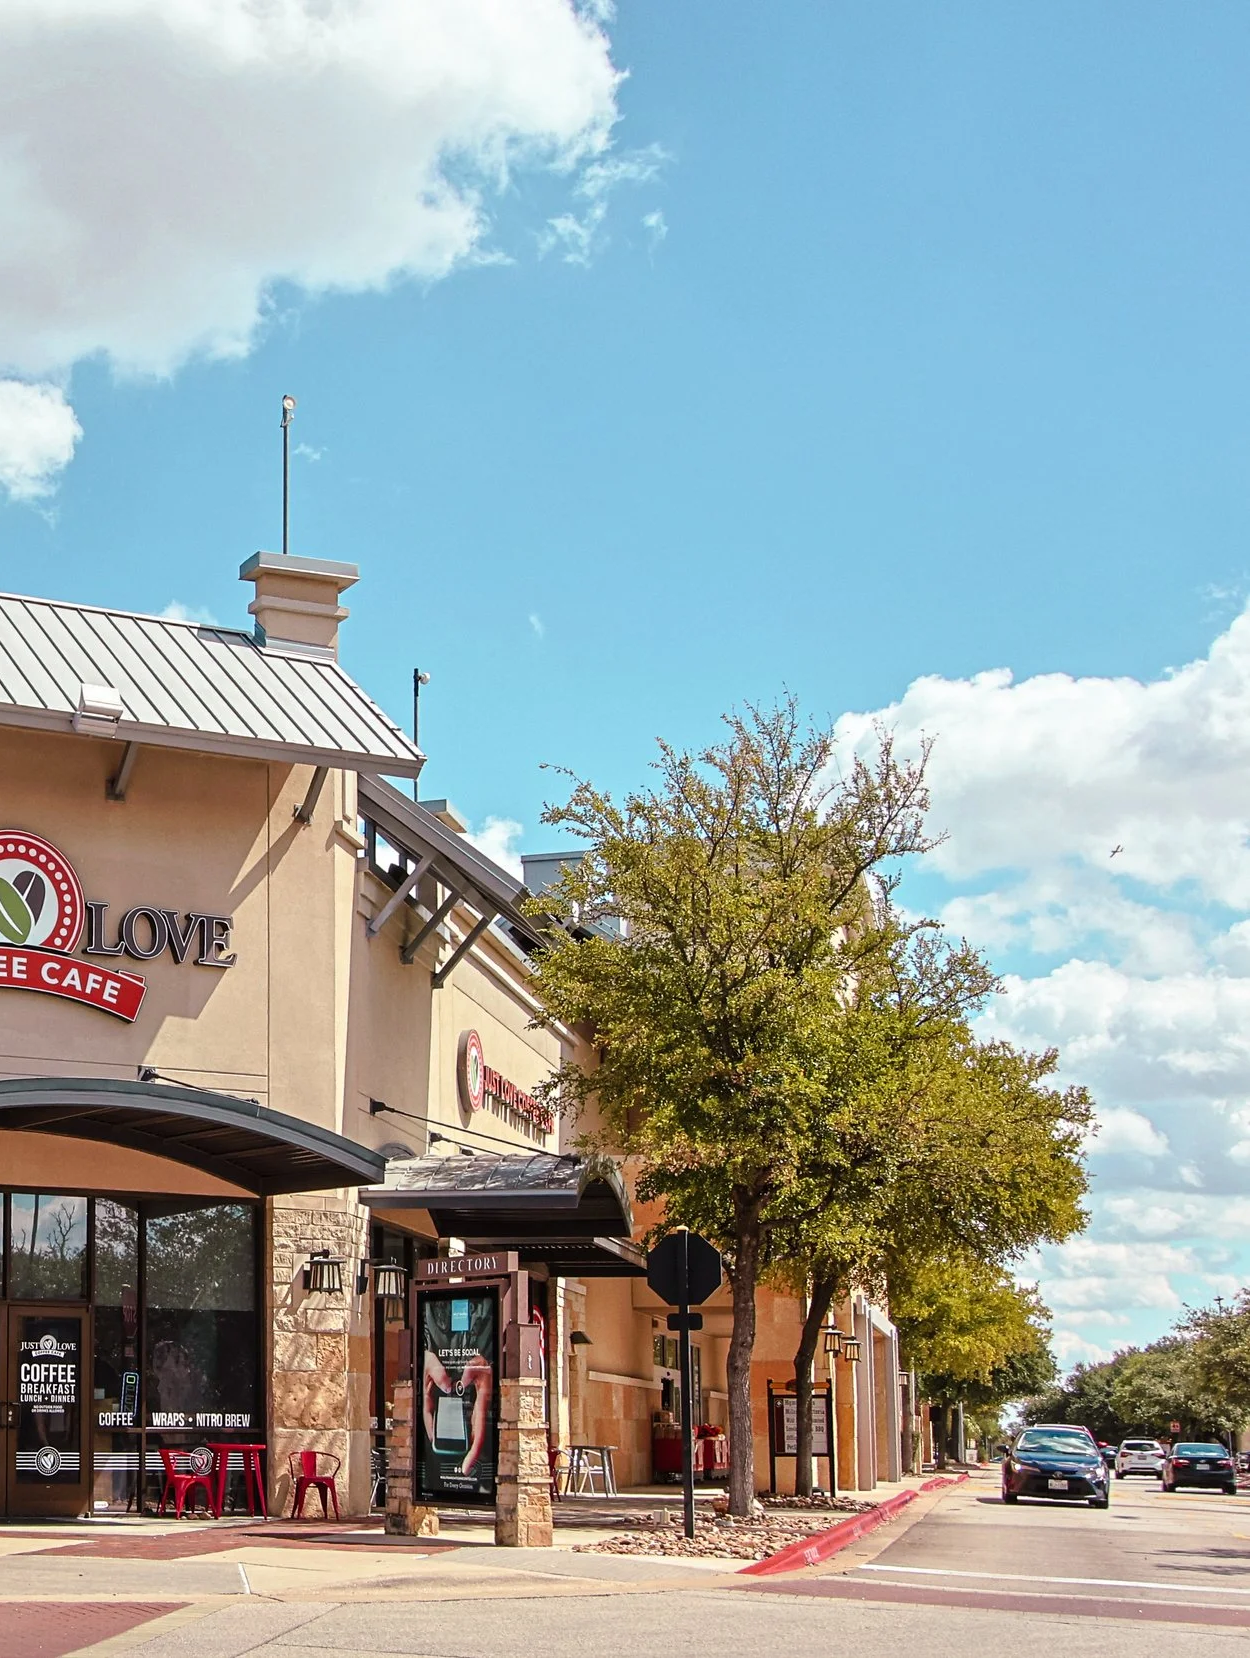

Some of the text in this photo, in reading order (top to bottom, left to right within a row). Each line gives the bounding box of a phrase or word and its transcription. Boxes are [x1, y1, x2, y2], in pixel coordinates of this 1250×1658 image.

[83, 901, 238, 968] LOVE
[41, 961, 121, 1005] CAFE
[427, 1256, 499, 1275] DIRECTORY
[20, 1341, 77, 1351] JUST LOVE
[454, 1348, 462, 1357] BE
[21, 1363, 76, 1383] COFFEE
[20, 1383, 76, 1395] BREAKFAST
[20, 1394, 43, 1403] LUNCH
[50, 1395, 76, 1403] DINNER
[98, 1412, 134, 1426] COFFEE
[152, 1412, 250, 1428] WRAPS NITRO BREW
